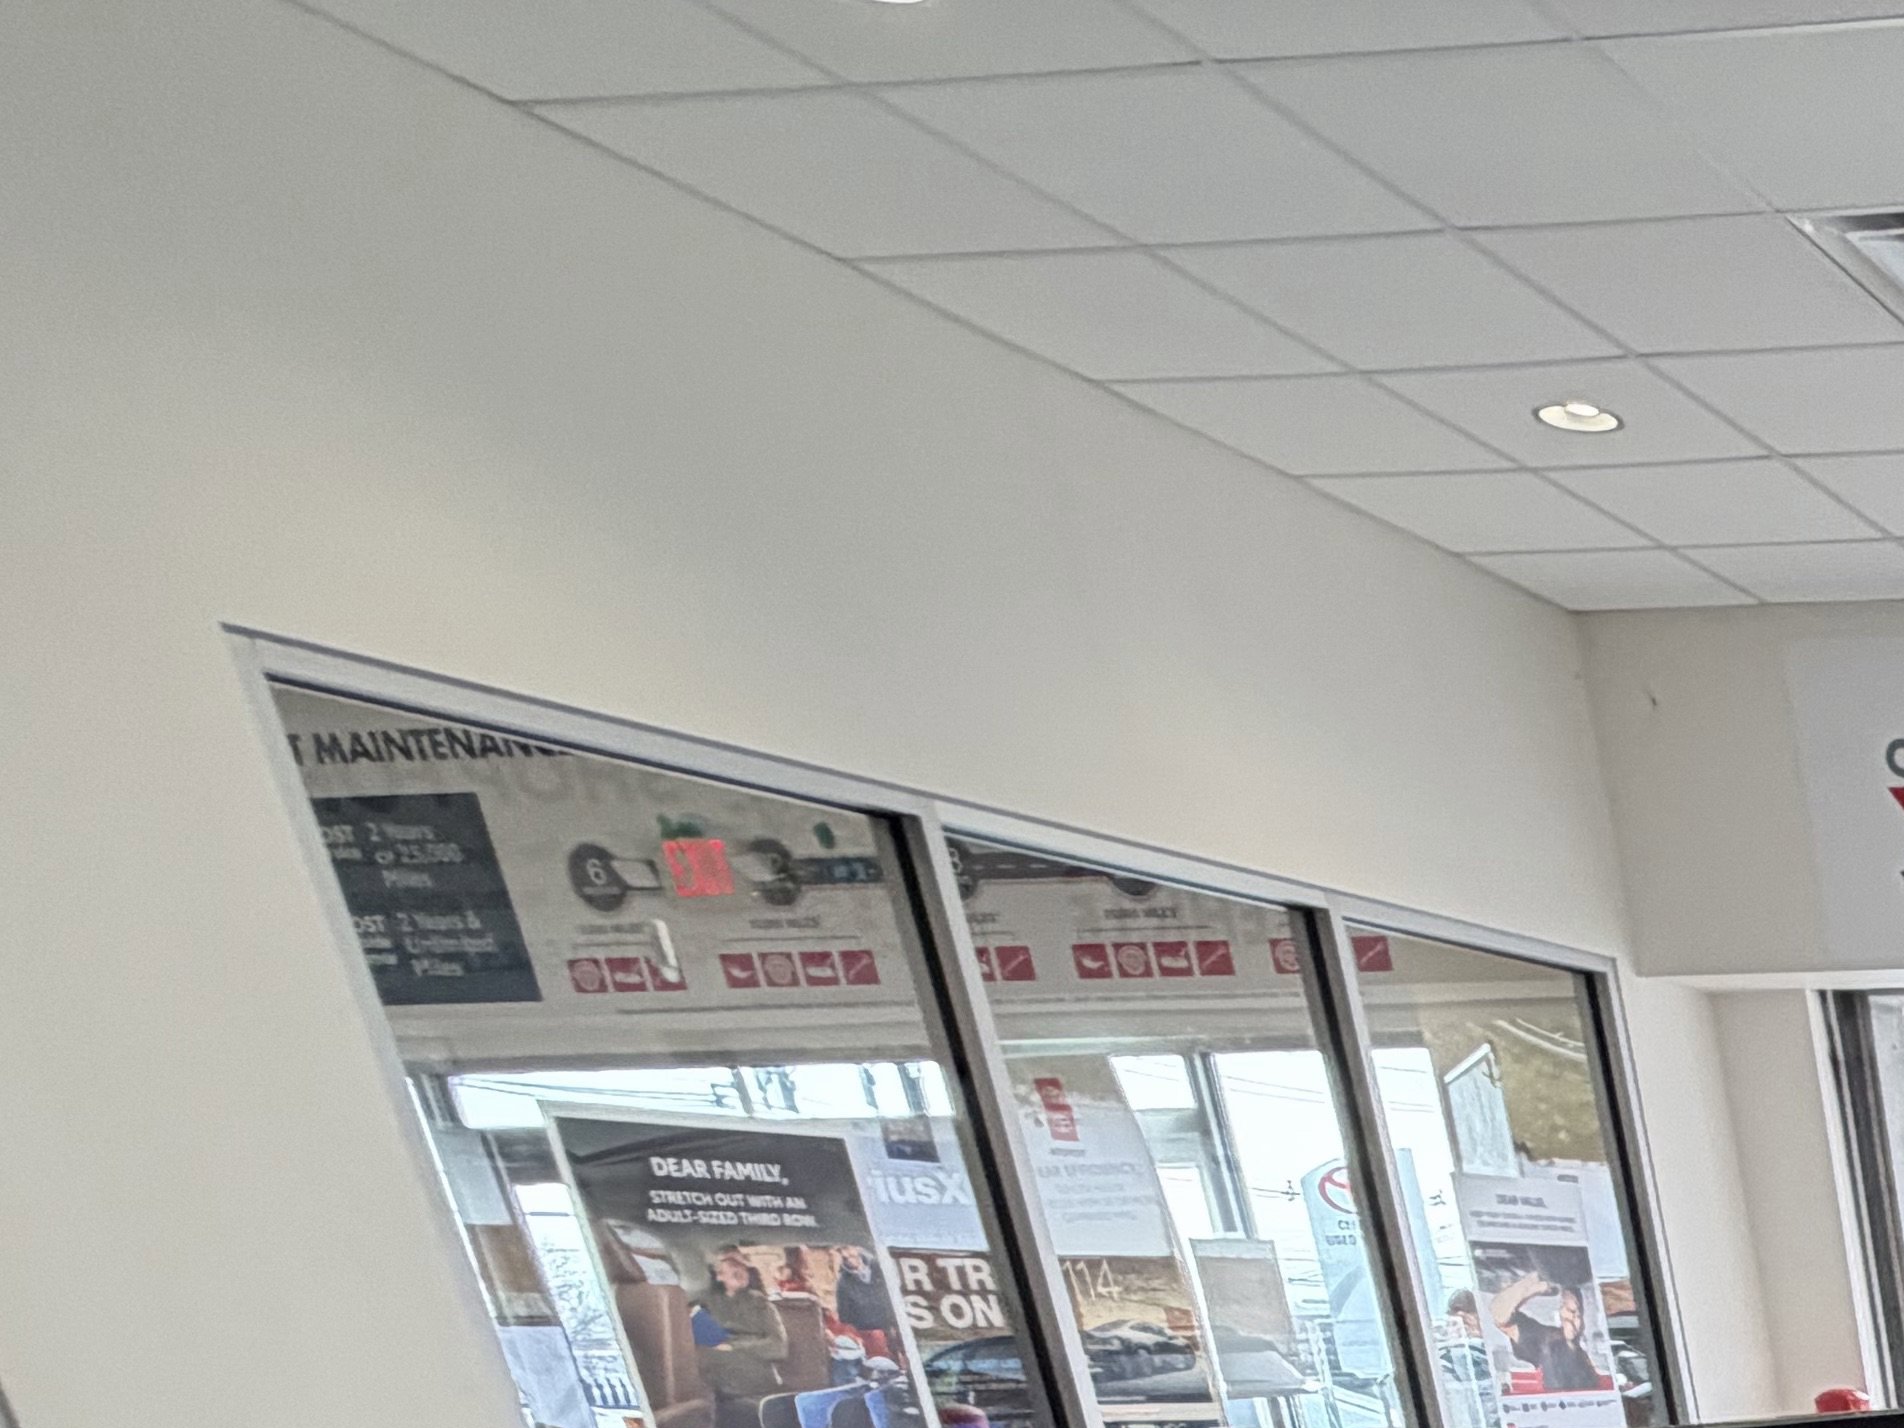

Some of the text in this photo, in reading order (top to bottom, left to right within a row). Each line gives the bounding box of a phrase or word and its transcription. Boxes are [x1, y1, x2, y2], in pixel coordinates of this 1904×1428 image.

[312, 727, 575, 765] MAINTENAN
[649, 1156, 711, 1180] DEAR
[649, 1190, 714, 1207] STRETCH
[715, 1192, 745, 1208] OUT
